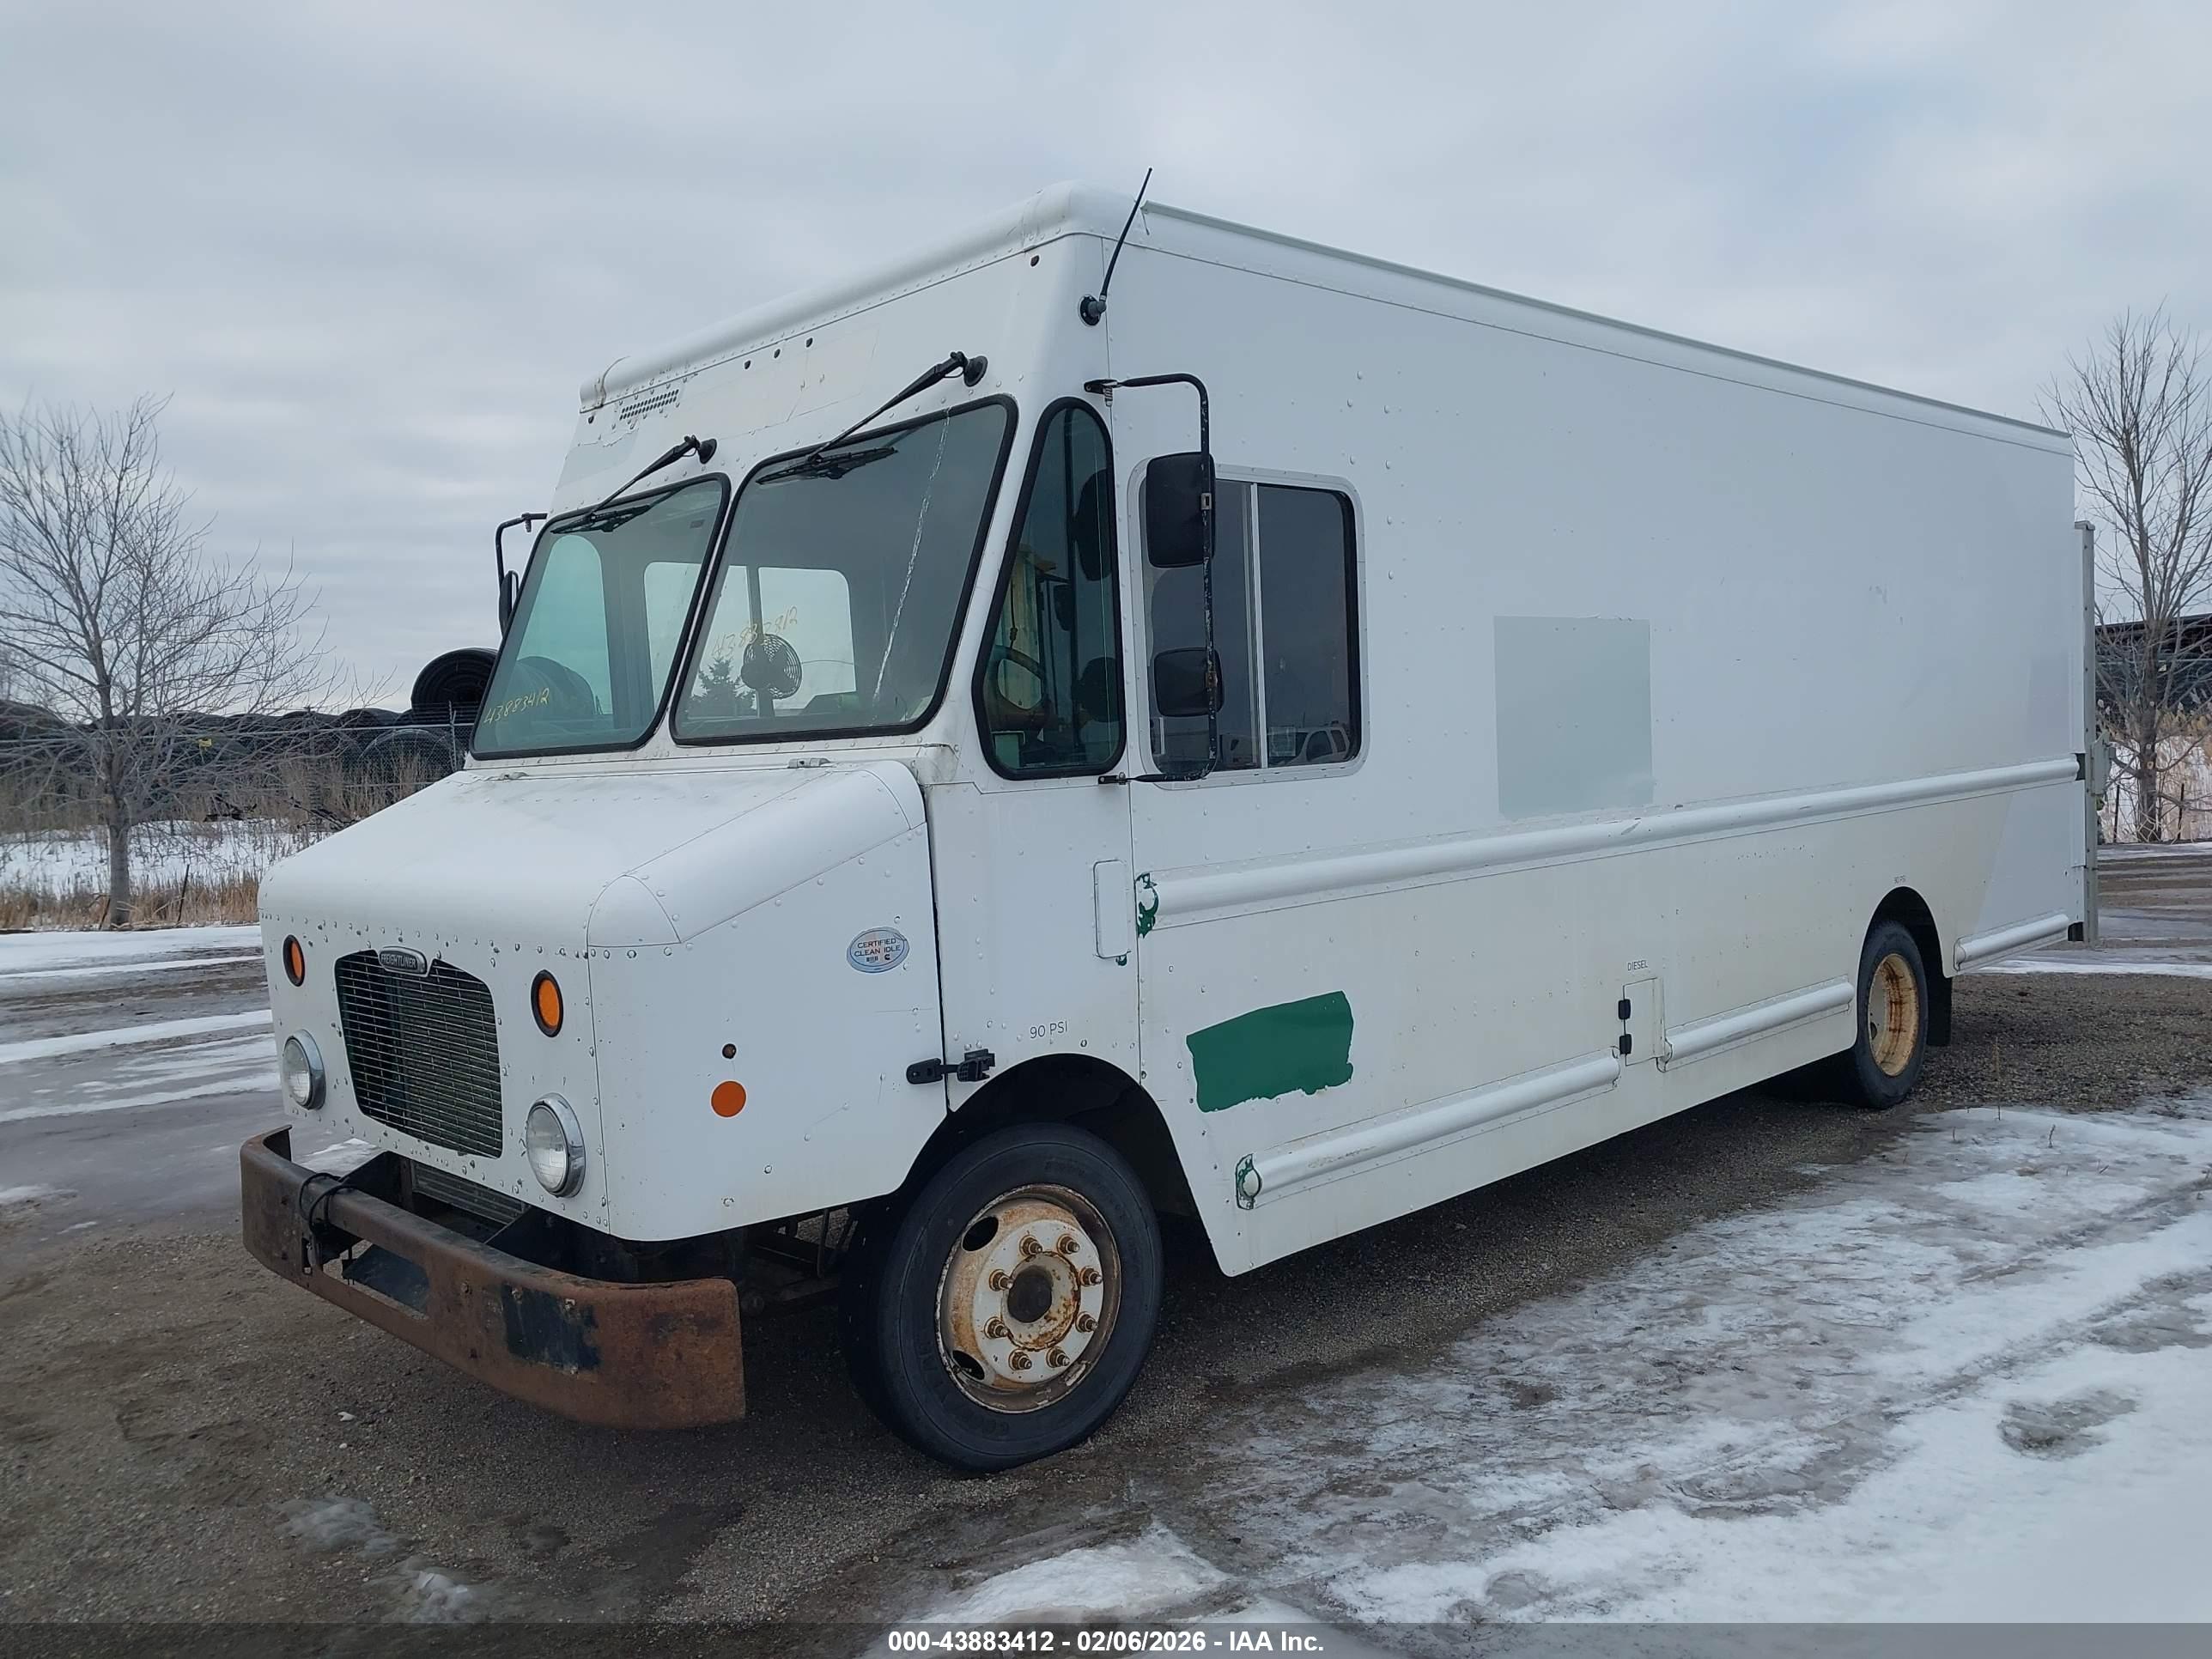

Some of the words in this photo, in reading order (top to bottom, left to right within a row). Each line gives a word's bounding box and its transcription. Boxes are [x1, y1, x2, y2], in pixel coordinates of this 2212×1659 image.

[483, 687, 550, 725] 43883412
[857, 938, 896, 949] CERTIFIED
[854, 948, 881, 957] CLEAN
[884, 945, 901, 953] IDLE
[1627, 959, 1649, 971] DIESEL
[1030, 1024, 1046, 1039] 90
[1049, 1020, 1068, 1036] PSI
